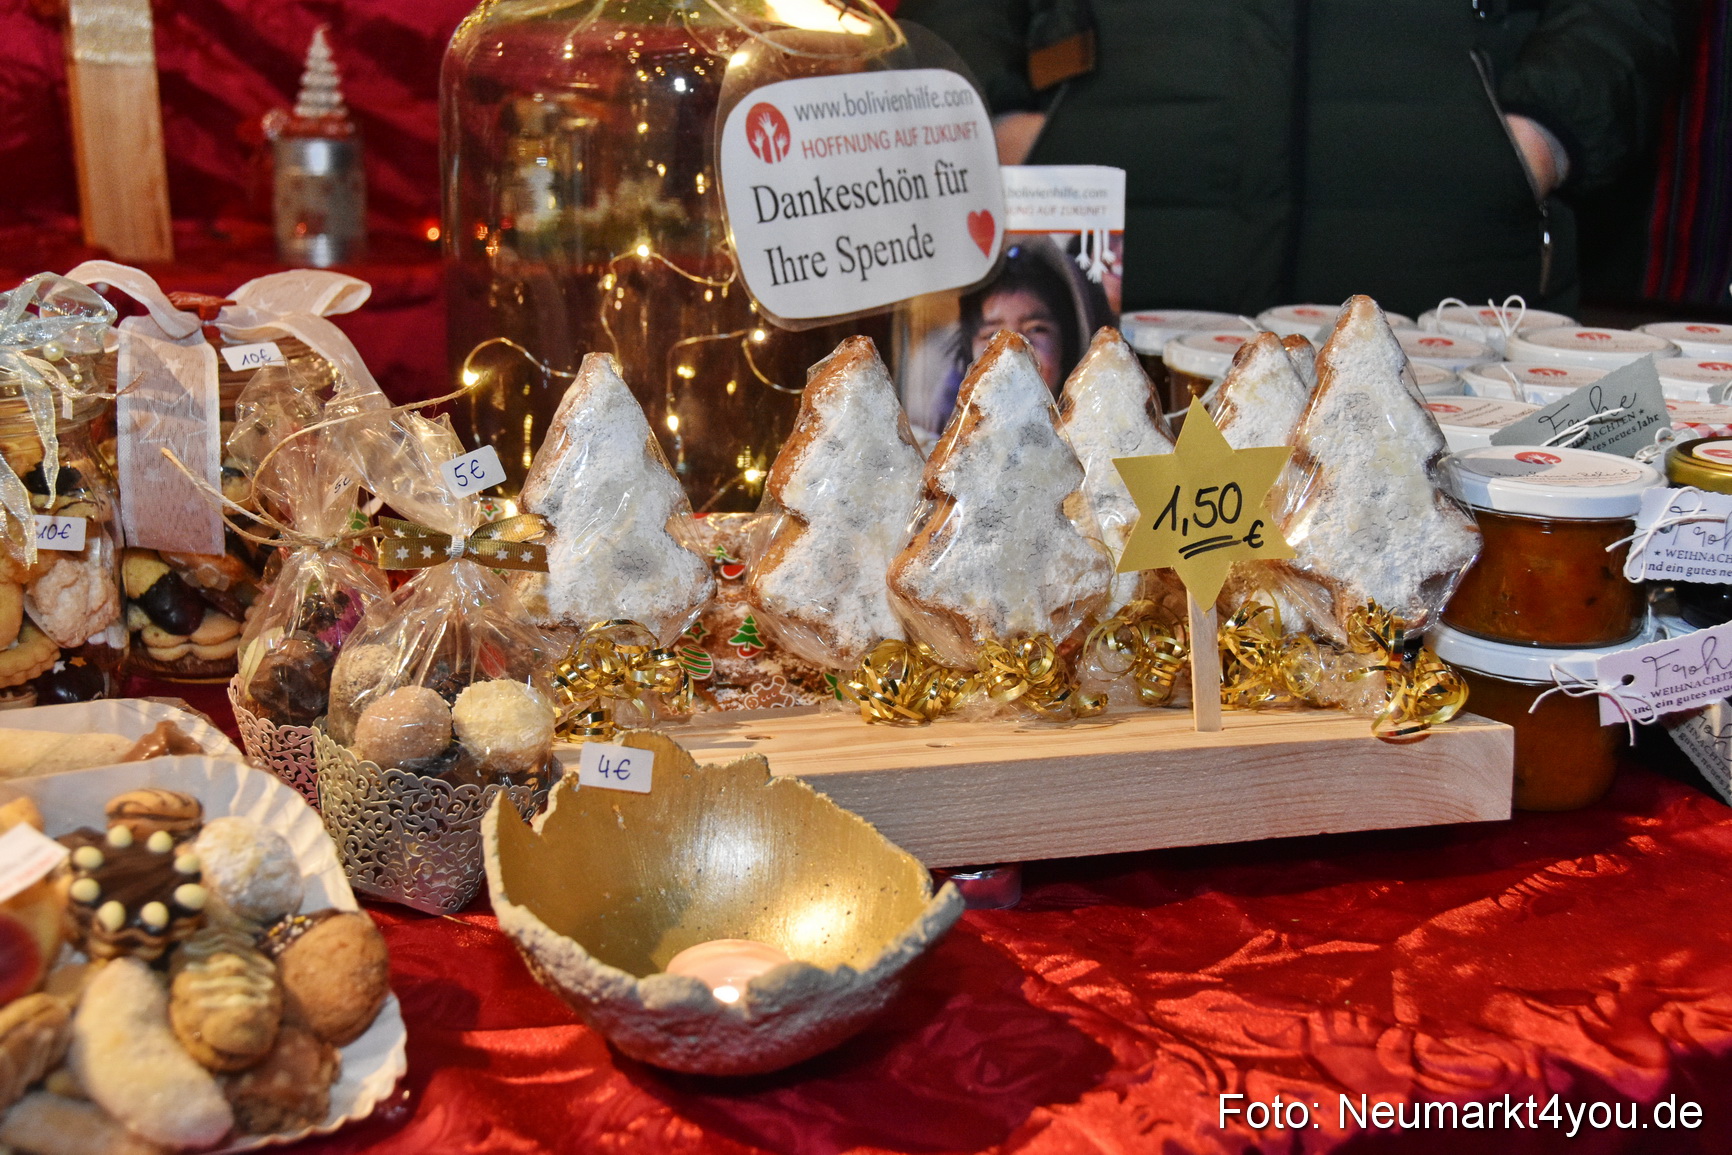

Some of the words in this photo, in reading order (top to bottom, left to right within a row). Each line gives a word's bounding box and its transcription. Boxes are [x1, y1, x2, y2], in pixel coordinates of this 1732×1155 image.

[793, 85, 974, 122] www.bolivienhilfe.com
[801, 130, 891, 160] HOFFNUNG
[895, 127, 919, 148] AUF
[924, 120, 979, 146] ZUKUNFT
[750, 166, 929, 224] Dankeschön
[934, 159, 969, 197] für
[764, 245, 828, 287] Ihre
[835, 223, 936, 281] Spende
[241, 348, 272, 366] 10€
[1608, 425, 1637, 445] neues
[1638, 413, 1660, 430] Jahr
[454, 459, 486, 487] 5€
[1153, 481, 1243, 536] 1,50
[1243, 519, 1264, 549] €
[37, 523, 72, 540] 10€
[1665, 562, 1684, 573] ein
[1685, 566, 1717, 577] gutes
[1655, 699, 1674, 709] ein
[1676, 691, 1707, 707] gutes
[598, 754, 631, 780] 4€
